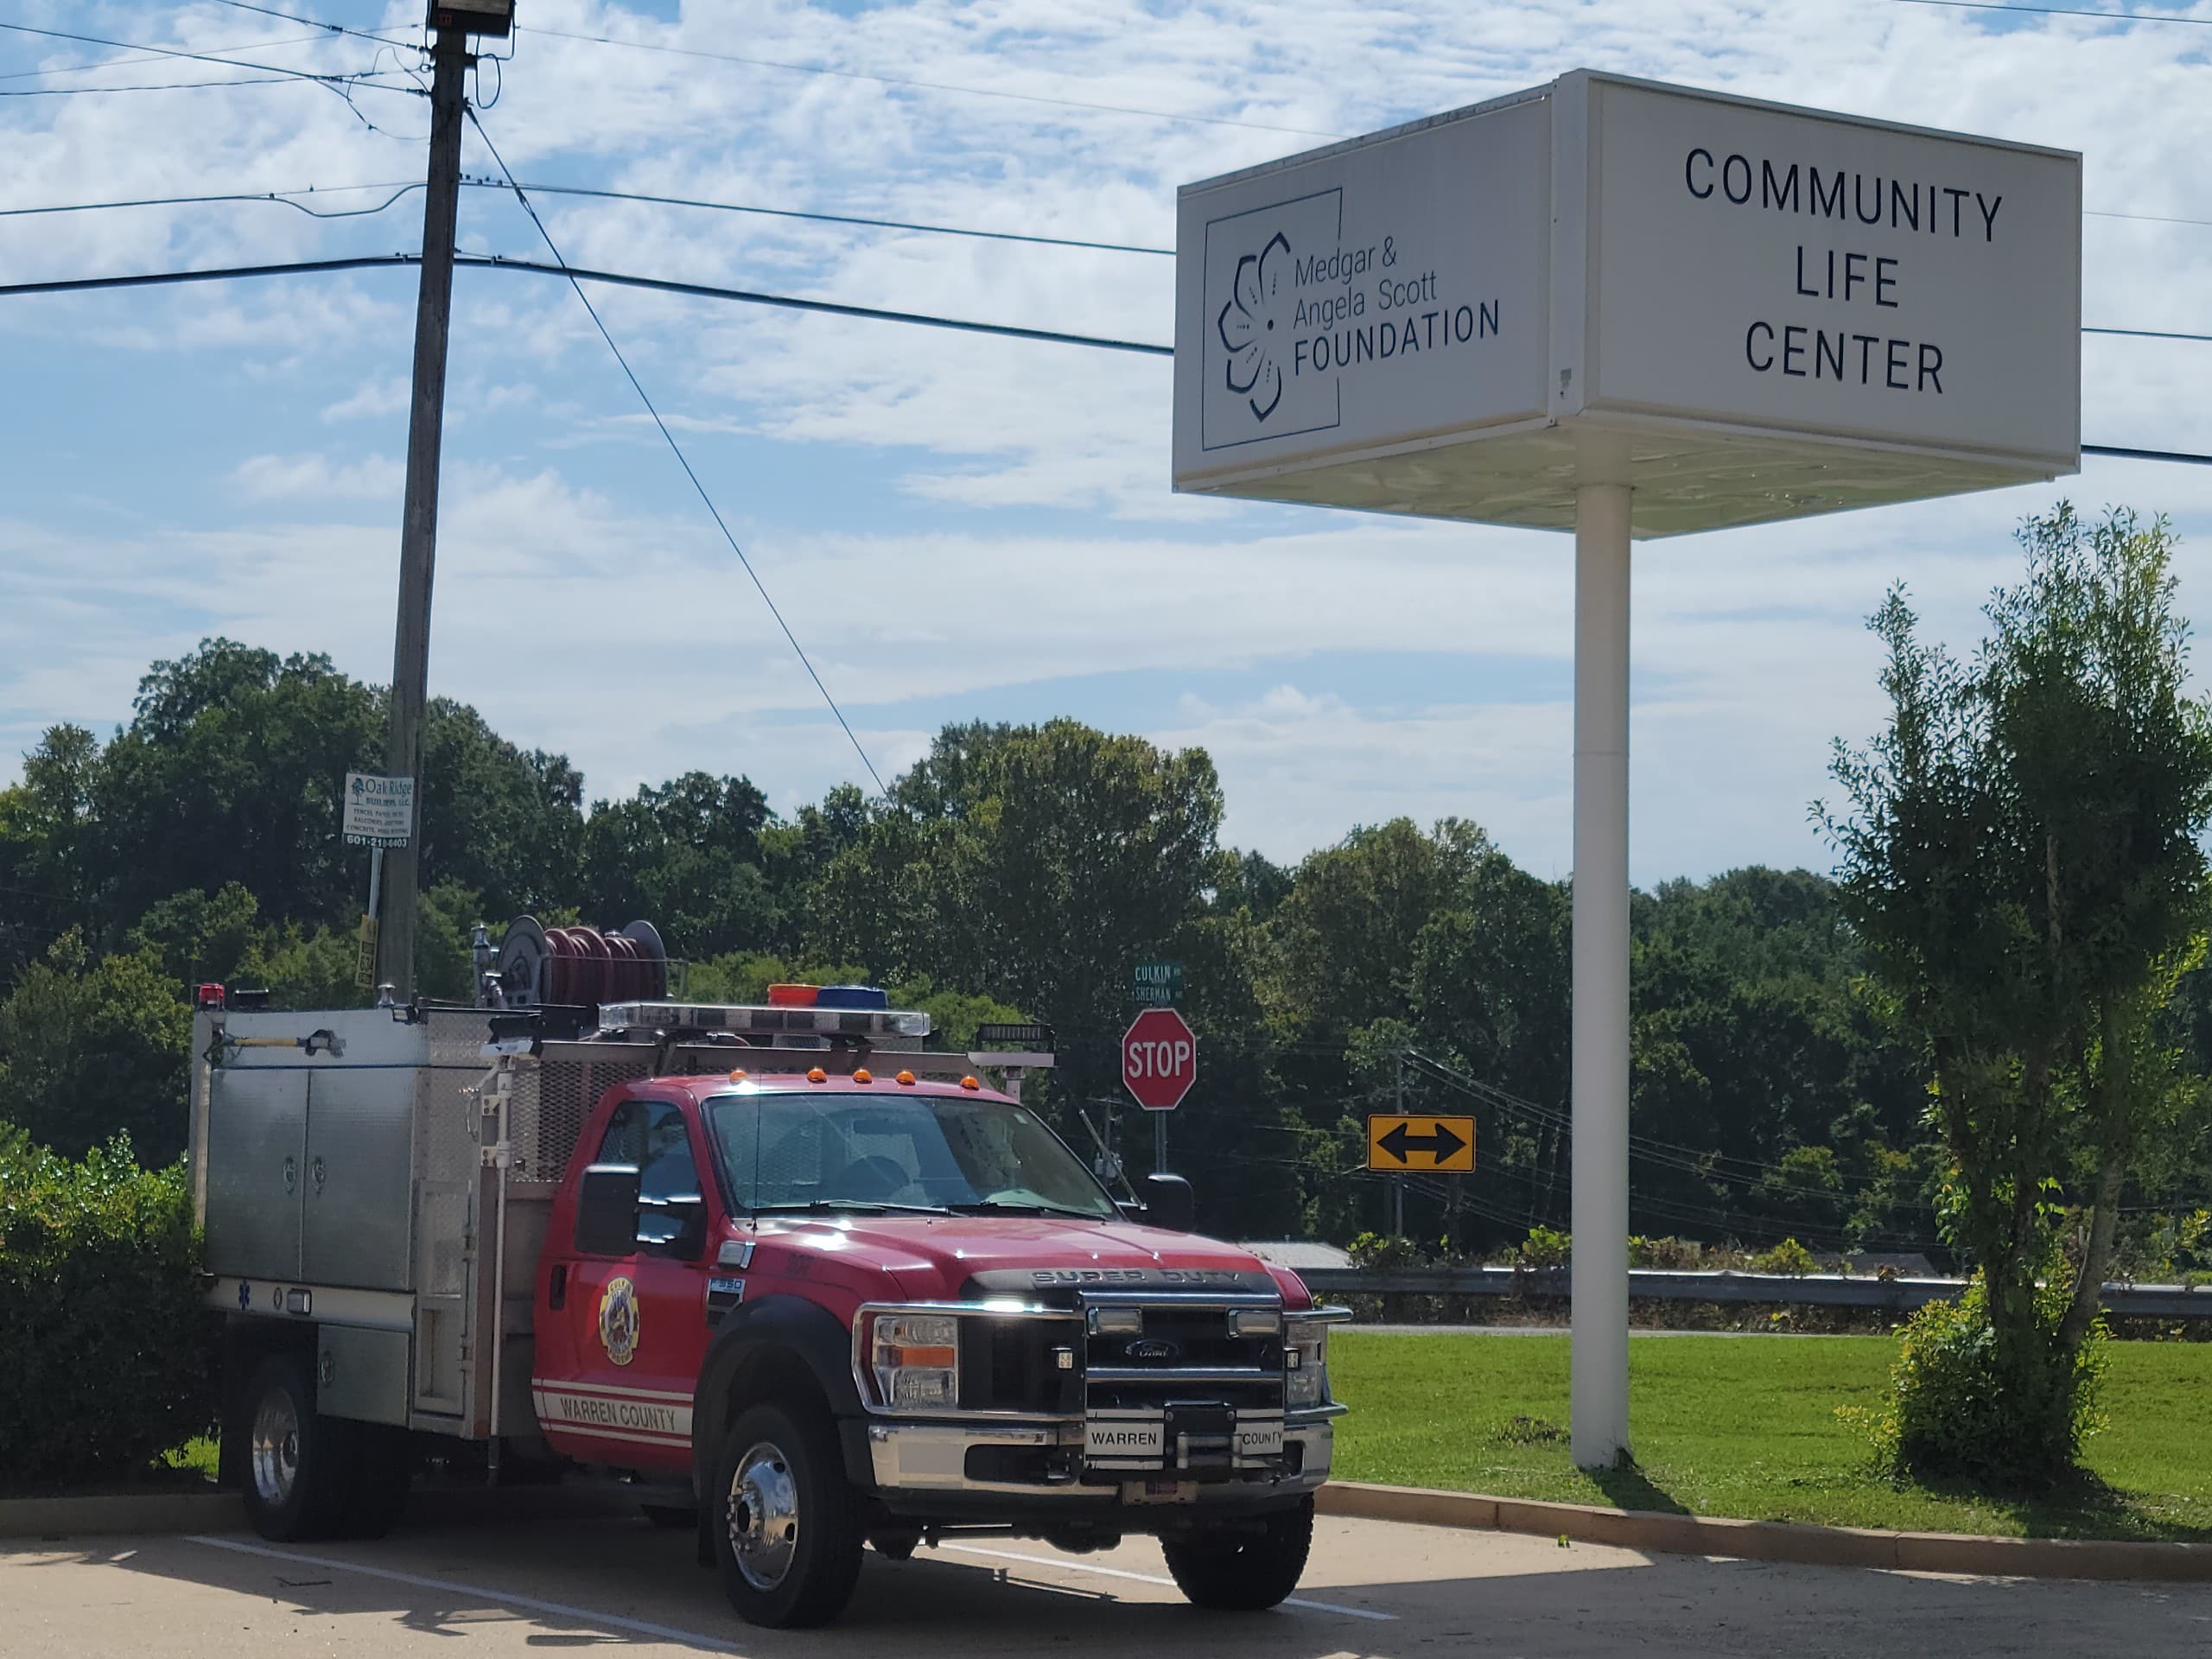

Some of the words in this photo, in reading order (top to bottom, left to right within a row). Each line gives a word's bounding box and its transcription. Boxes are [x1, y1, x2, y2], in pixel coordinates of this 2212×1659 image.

[1685, 148, 2002, 242] COMMUNITY
[1294, 247, 1376, 288] Medgar
[1382, 236, 1396, 267] &
[1796, 245, 1898, 308] LIFE
[1294, 287, 1364, 331] Angela
[1378, 270, 1437, 310] Scott
[1294, 299, 1499, 376] FOUNDATION
[1745, 321, 1943, 394] CENTER
[365, 778, 387, 795] Oak
[1135, 965, 1171, 982] CULKIN
[1128, 1040, 1190, 1078] STOP
[1031, 1270, 1147, 1284] SUPER
[1160, 1271, 1240, 1284] DUTY
[560, 1397, 617, 1425] WARREN
[620, 1404, 677, 1431] COUNTY
[1091, 1431, 1158, 1446] WARREN
[1243, 1431, 1283, 1446] COUNTY
